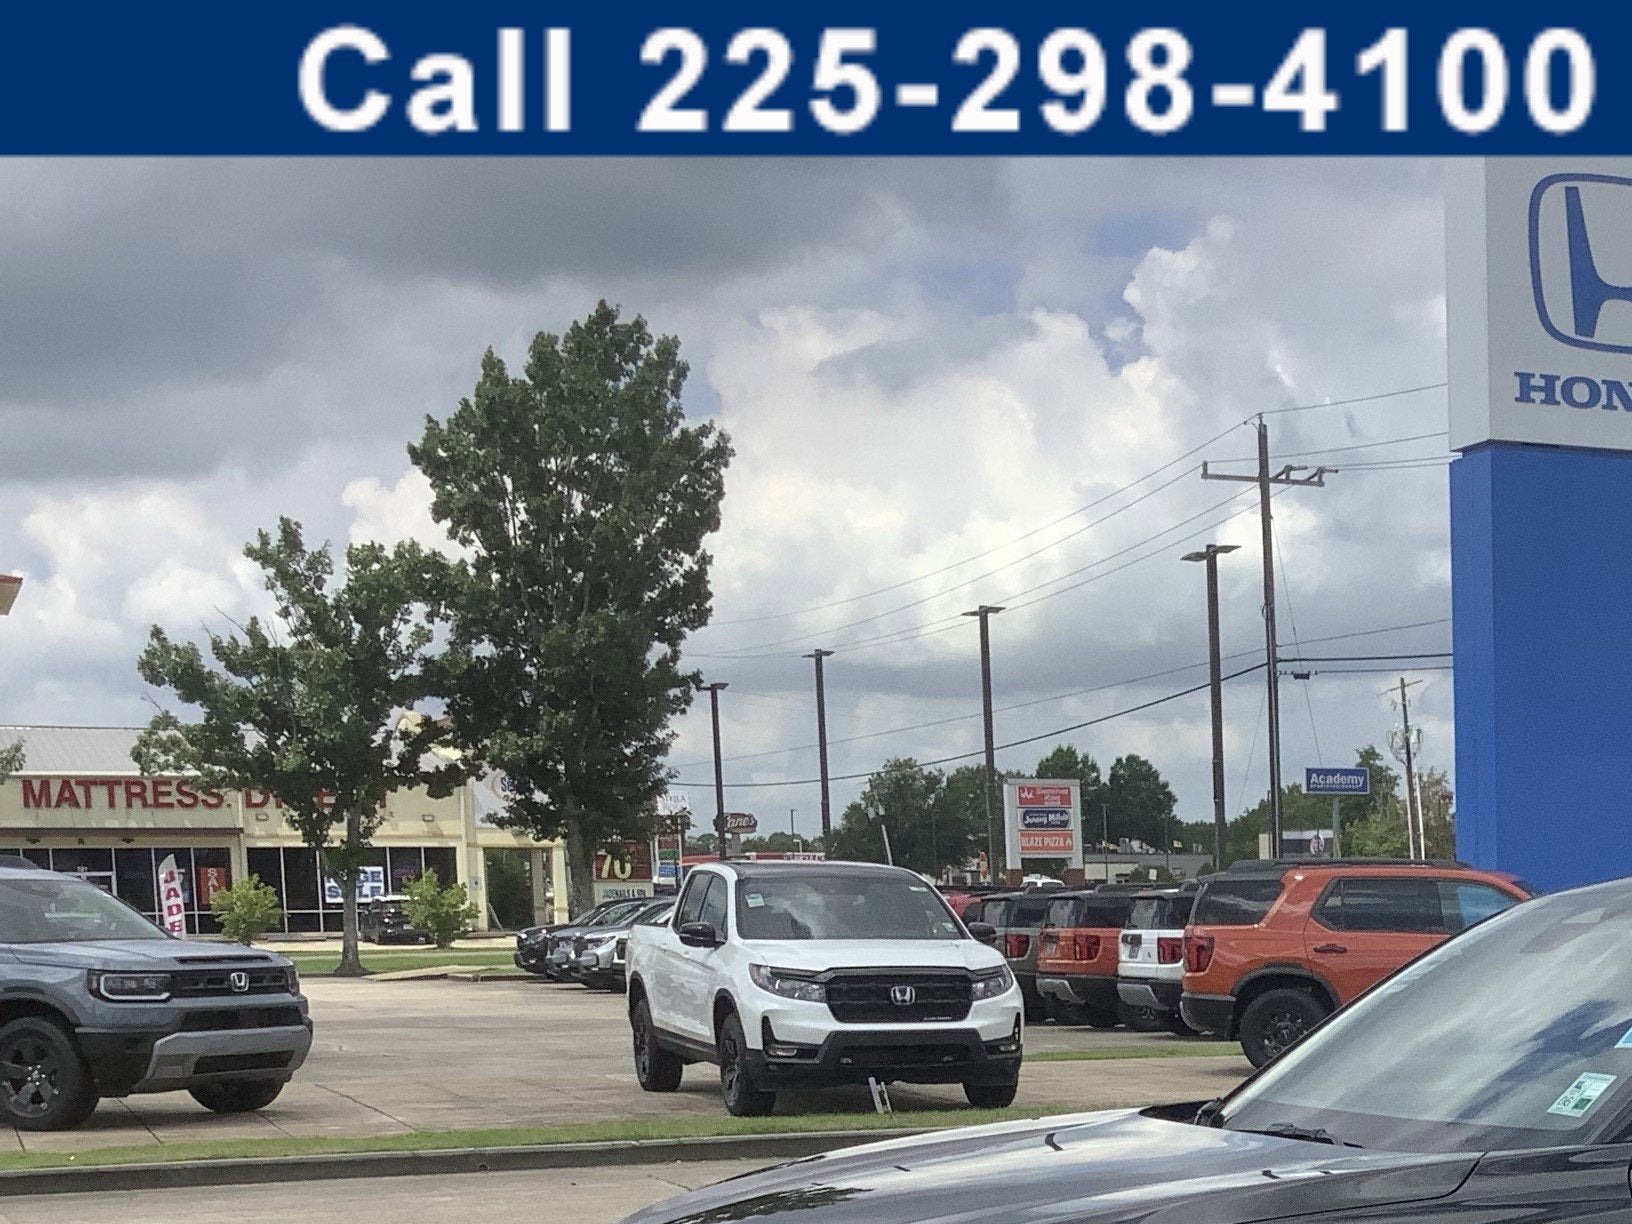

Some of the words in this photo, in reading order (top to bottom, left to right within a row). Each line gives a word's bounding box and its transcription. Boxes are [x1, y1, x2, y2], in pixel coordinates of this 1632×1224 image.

[1310, 772, 1365, 788] Academy
[20, 778, 226, 810] MATTRESS
[326, 885, 382, 899] SLE
